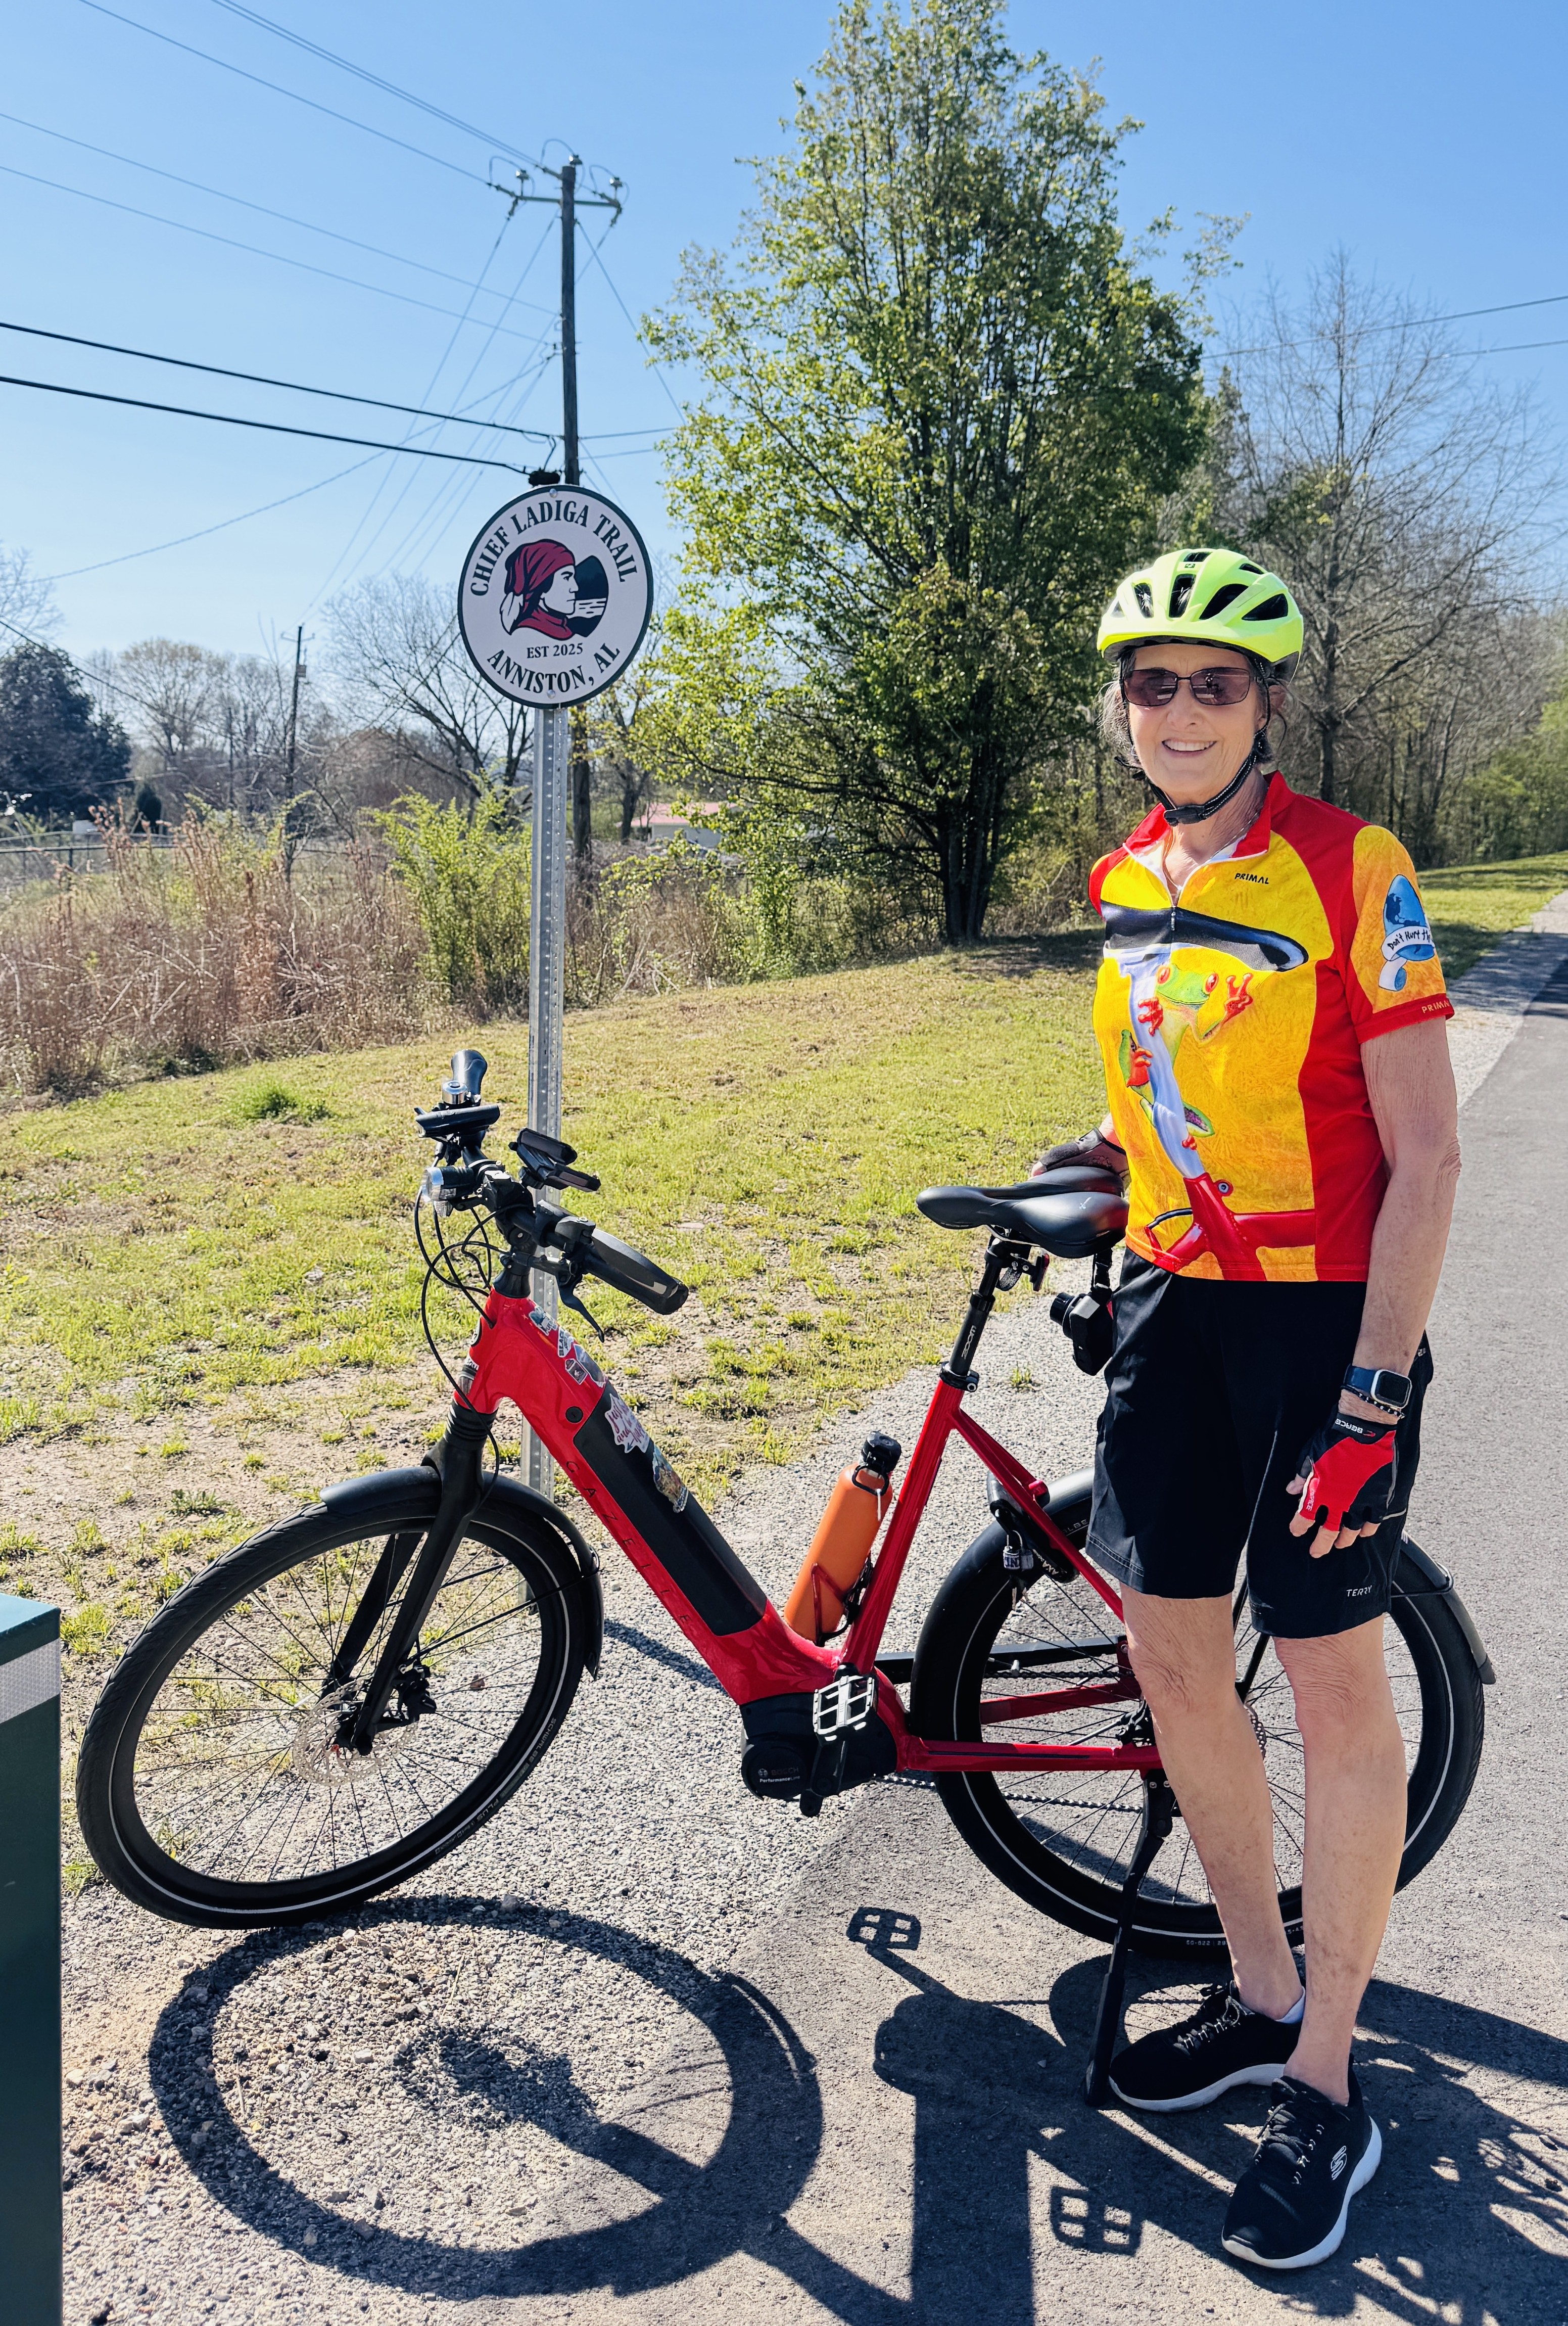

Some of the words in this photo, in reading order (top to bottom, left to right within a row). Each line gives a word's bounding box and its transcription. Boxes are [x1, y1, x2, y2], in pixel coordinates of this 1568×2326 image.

[470, 526, 508, 596] CHIEF
[510, 500, 589, 535] LADIGA
[593, 514, 638, 583] TRAIL
[527, 646, 549, 659] EST
[553, 642, 583, 657] 2025
[487, 649, 595, 693] ANNISTON,
[593, 642, 621, 673] AL
[1234, 873, 1269, 885] PRIMAL
[1387, 933, 1404, 951] Don't
[1421, 1000, 1450, 1014] PRIMA
[565, 1461, 691, 1624] GAZELLE
[1346, 1585, 1372, 1597] TERRY
[528, 1717, 557, 1763] SCHWALBE
